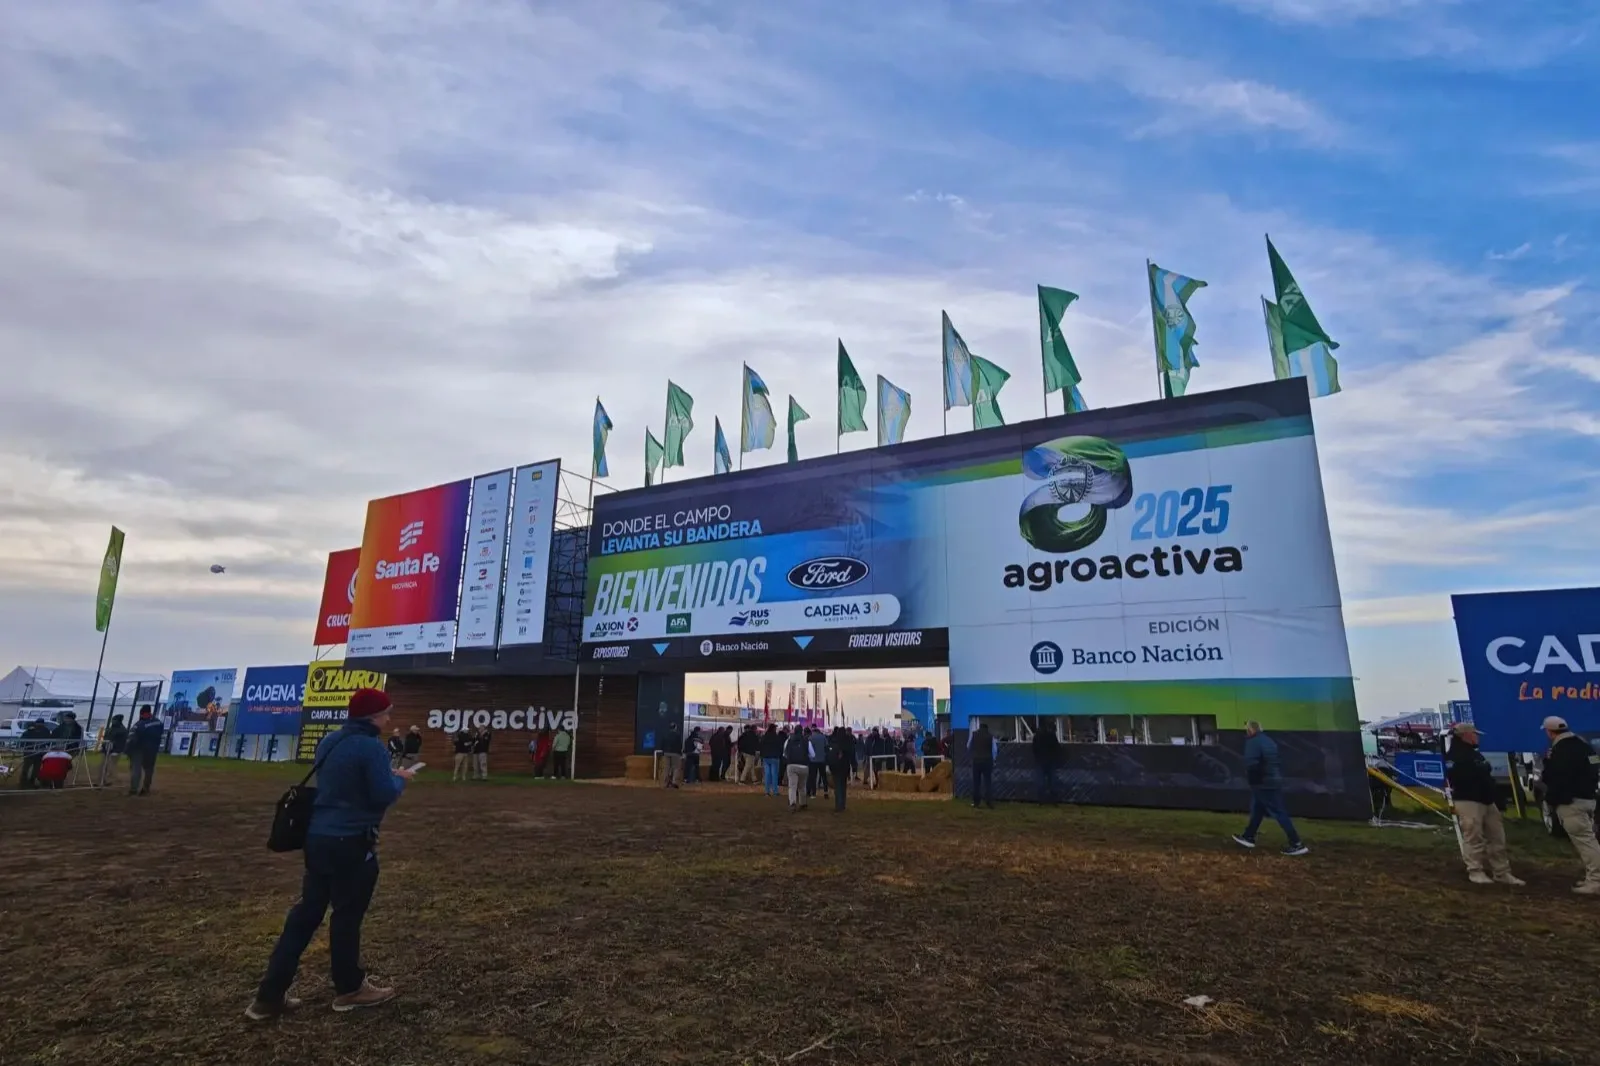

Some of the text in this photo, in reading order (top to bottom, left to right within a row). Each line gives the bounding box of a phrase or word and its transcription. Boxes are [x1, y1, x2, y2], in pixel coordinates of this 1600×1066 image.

[602, 504, 731, 538] DONDE EL CAMPO
[1130, 484, 1233, 541] 2025
[601, 519, 763, 555] LEVANTA SU BANDERA
[375, 552, 440, 580] Santa Fe
[802, 560, 853, 586] Ford
[1002, 543, 1244, 592] agroactiva
[391, 581, 418, 590] PROVINCIA
[591, 556, 767, 617] BIENVENIDOS
[750, 609, 769, 618] RUS
[804, 602, 872, 618] CADENA 3
[594, 621, 625, 631] AXION
[670, 617, 687, 626] AFA
[748, 618, 769, 627] Agro
[1148, 616, 1220, 635] EDICIÓN
[715, 640, 769, 651] Banco Nación
[848, 631, 922, 648] FOREIGN VISITORS
[593, 645, 630, 659] EXPOSITORES
[1071, 642, 1224, 665] Banco Nación
[324, 669, 379, 690] TAURO
[246, 683, 306, 702] CADENA 3
[1518, 681, 1600, 700] La radi
[311, 709, 333, 720] CARPA
[427, 705, 579, 733] agroactiva
